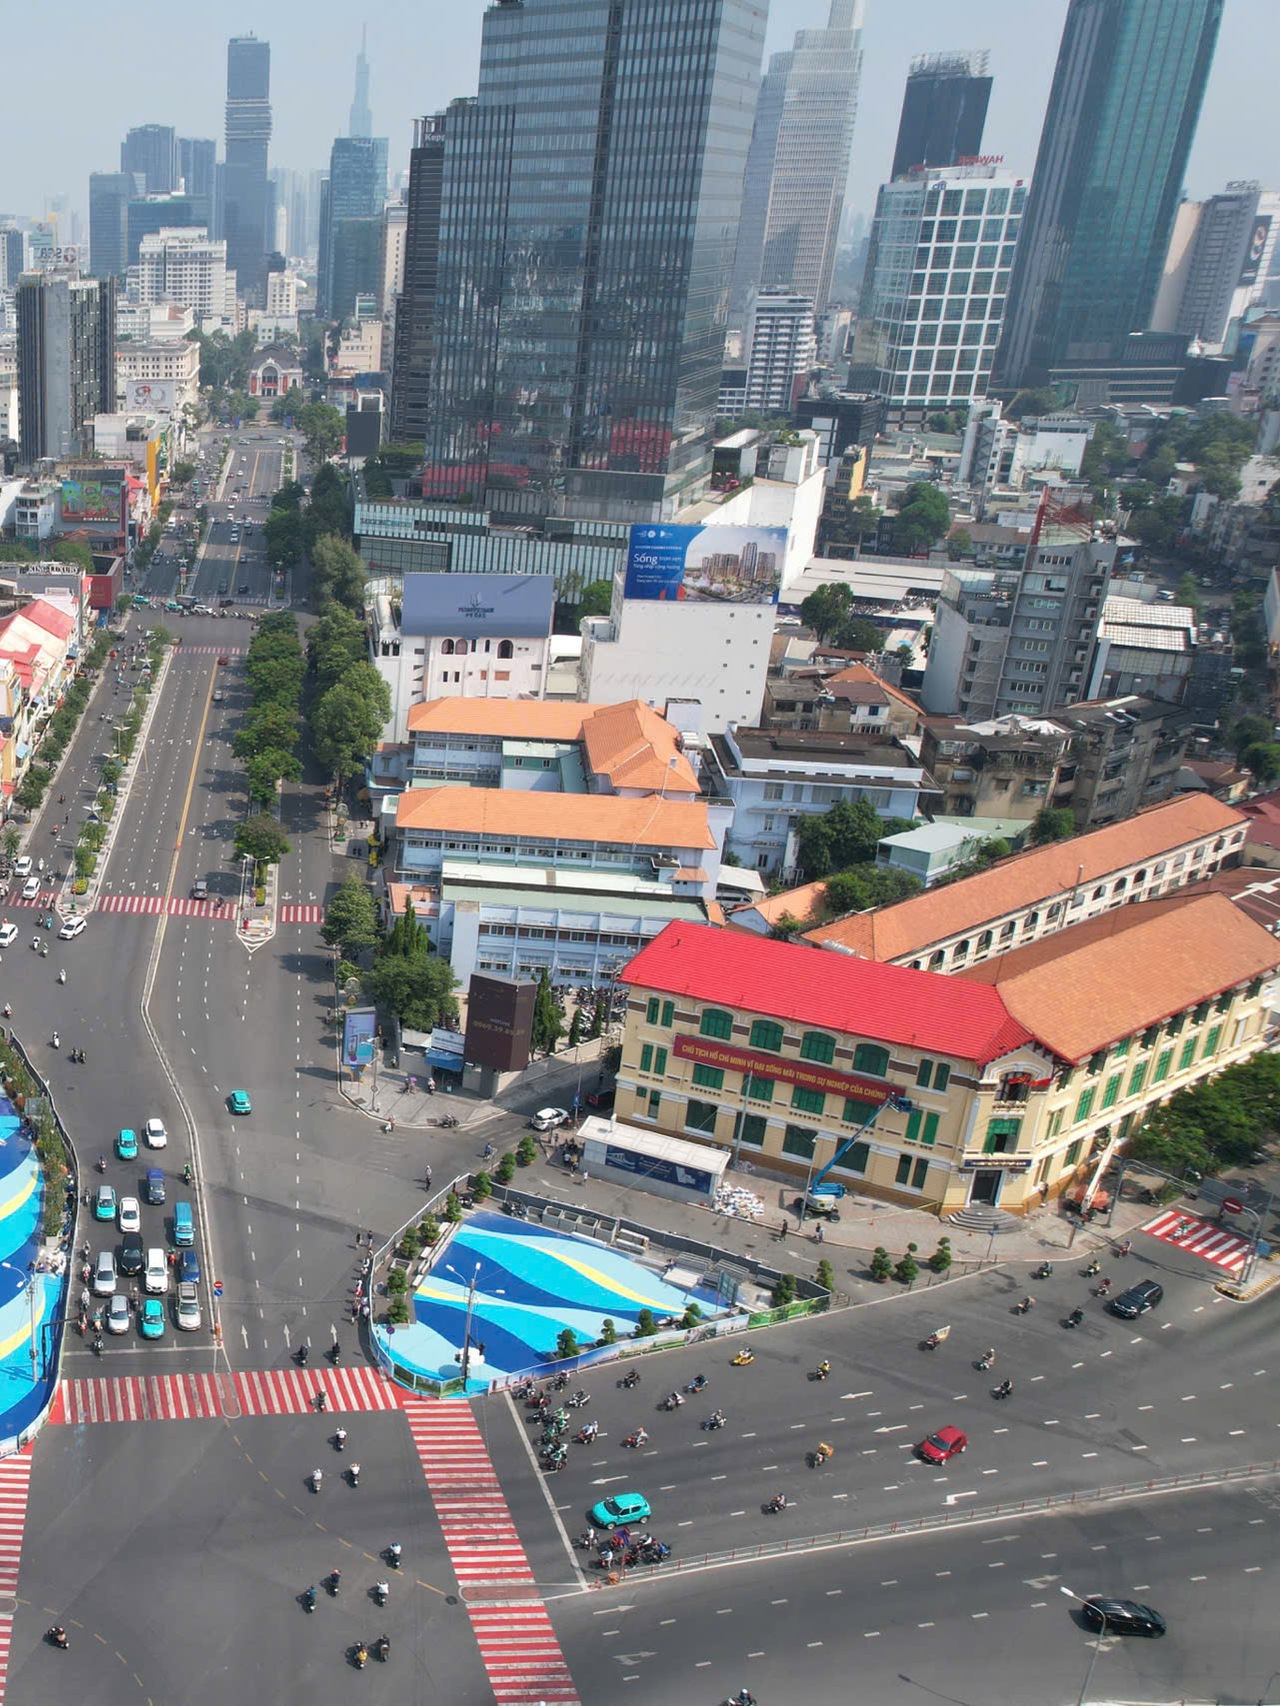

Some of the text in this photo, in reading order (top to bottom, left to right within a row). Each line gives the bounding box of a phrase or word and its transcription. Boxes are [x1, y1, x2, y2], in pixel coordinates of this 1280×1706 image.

[633, 552, 658, 565] Sống
[730, 1056, 747, 1067] MINH
[796, 1071, 816, 1084] TRONG
